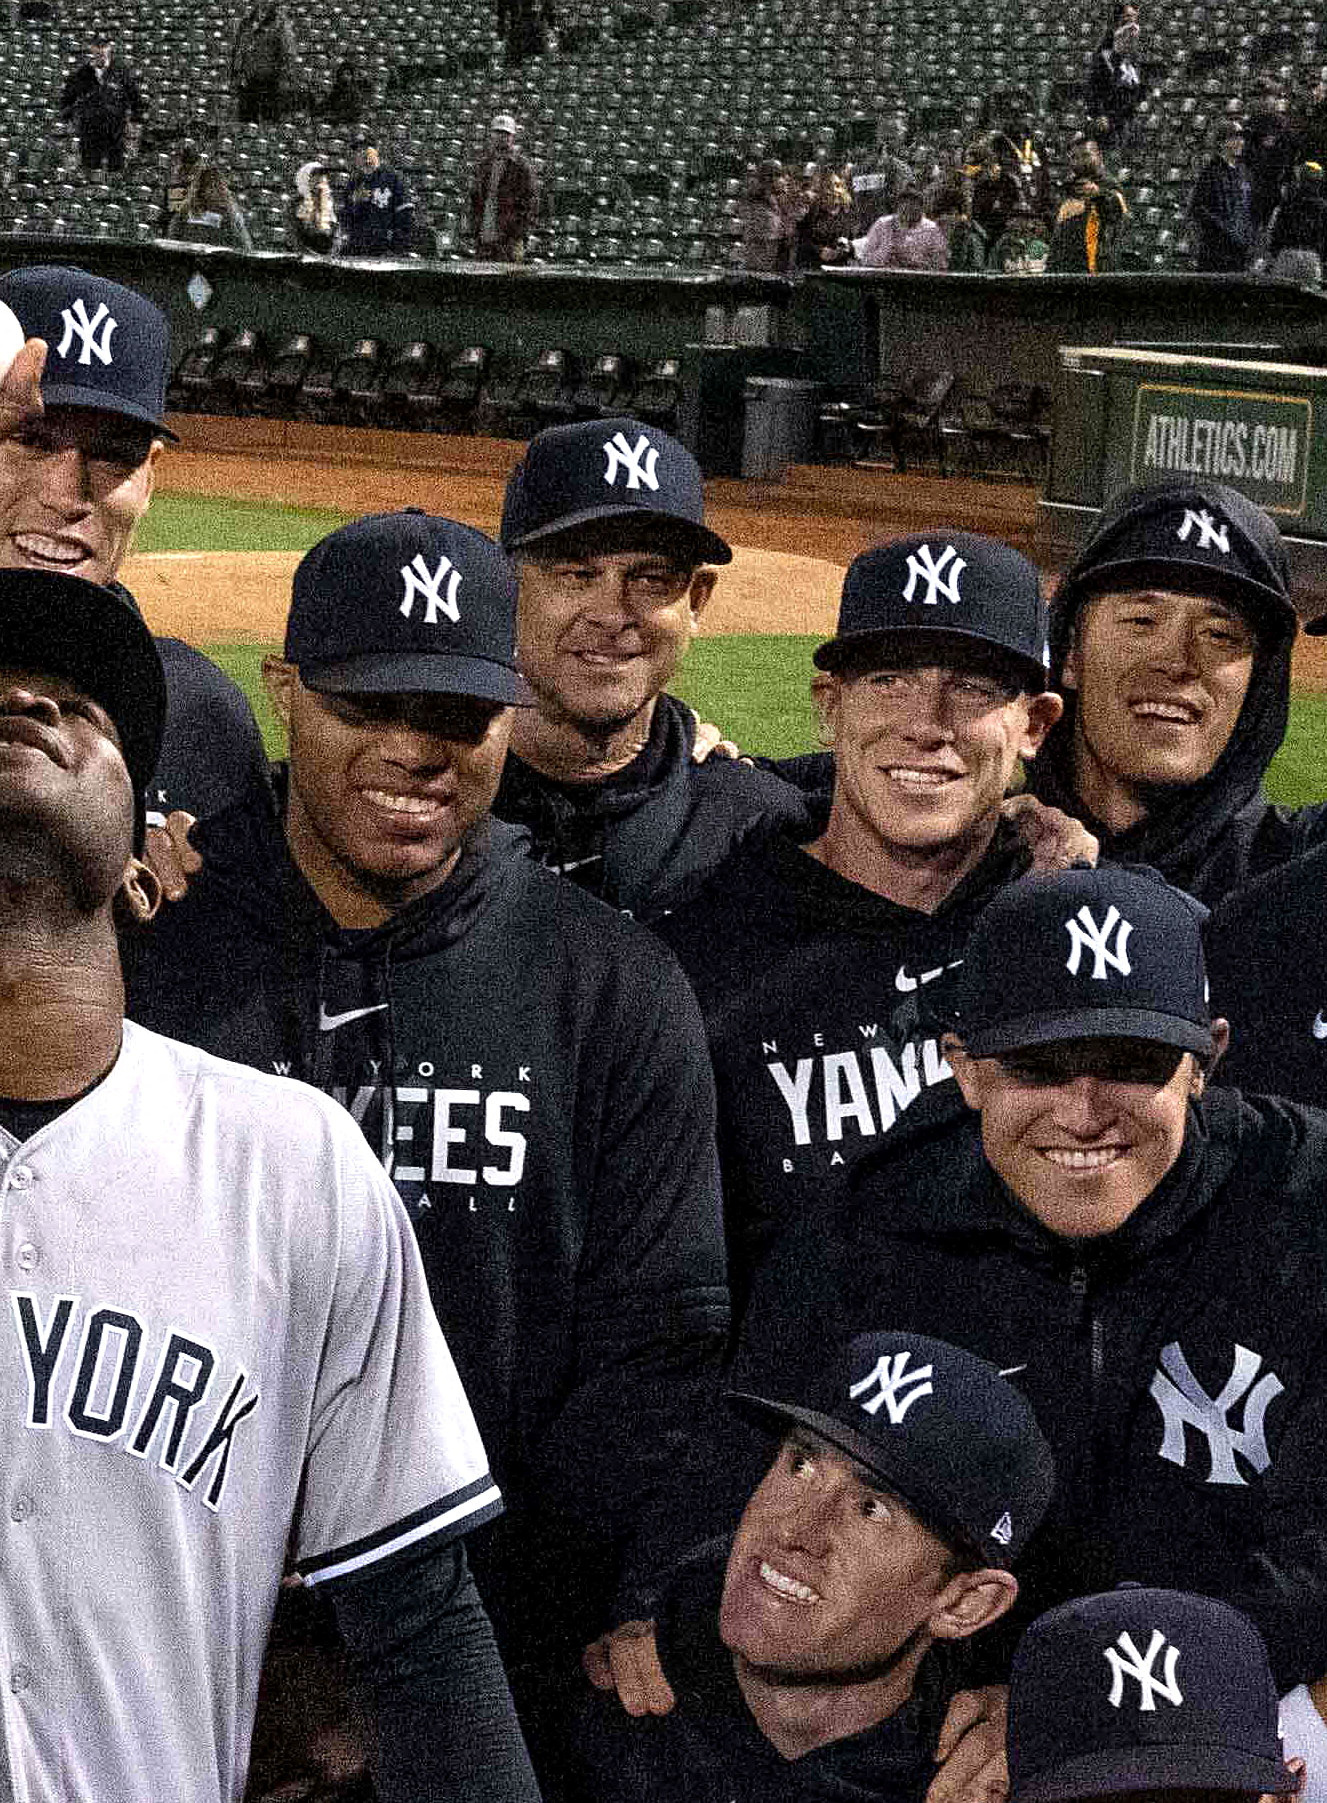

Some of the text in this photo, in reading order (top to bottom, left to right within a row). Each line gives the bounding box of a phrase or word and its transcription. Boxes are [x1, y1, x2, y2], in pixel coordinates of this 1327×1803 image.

[57, 299, 117, 365] NY
[604, 433, 659, 490] NY
[1146, 414, 1297, 483] ATHLETICS.COM
[400, 554, 462, 623] NY
[903, 545, 966, 604] NY
[1066, 906, 1133, 979] NY
[763, 1024, 878, 1053] NEW
[11, 1290, 260, 1513] YORK
[1150, 1342, 1284, 1485] NY
[1104, 1630, 1183, 1710] NY
